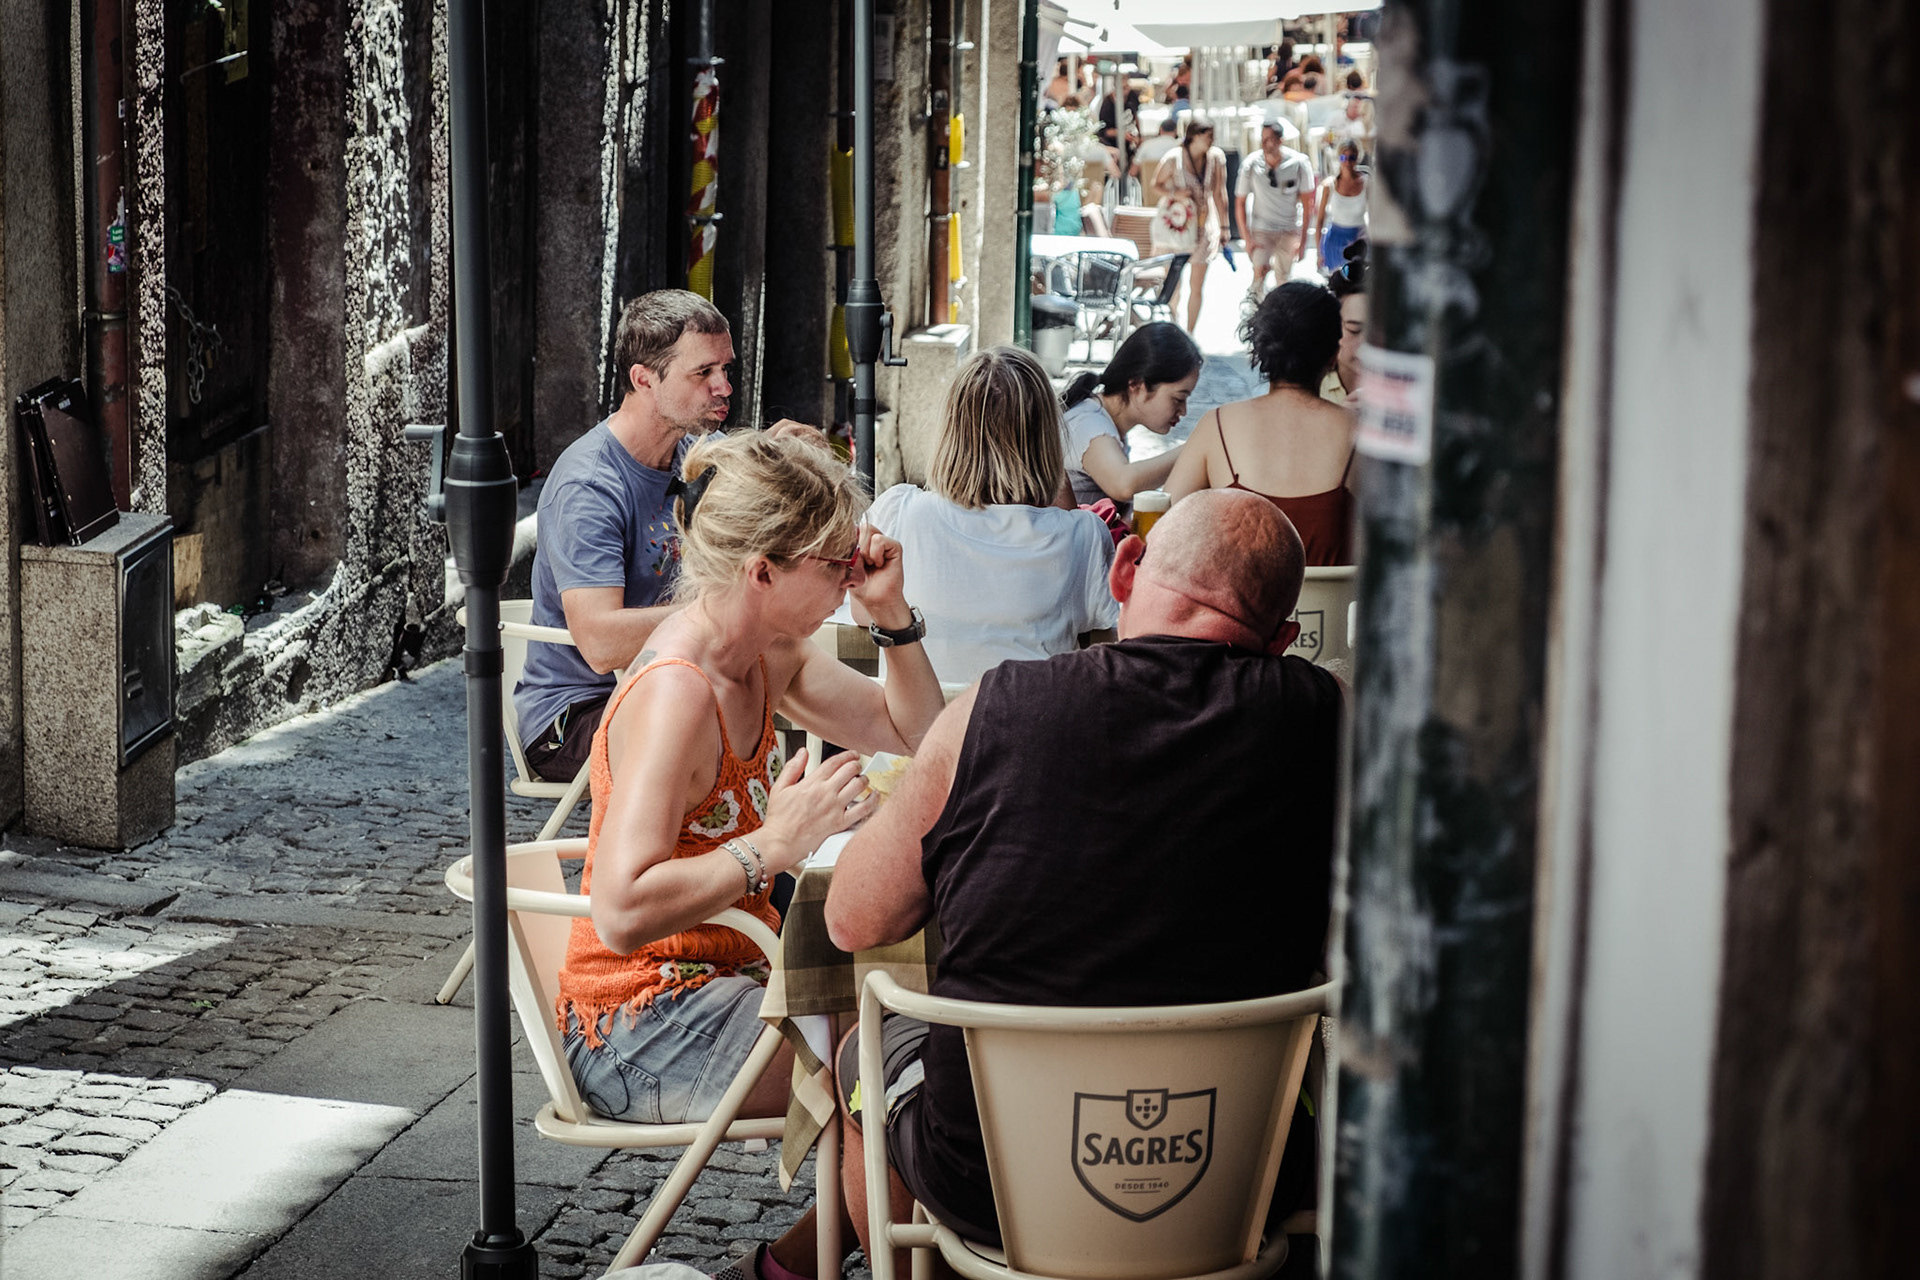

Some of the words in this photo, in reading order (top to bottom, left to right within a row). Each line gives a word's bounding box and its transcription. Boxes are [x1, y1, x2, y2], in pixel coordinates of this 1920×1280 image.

[1082, 1129, 1203, 1166] SAGRES
[1114, 1182, 1145, 1190] DESDE
[1148, 1181, 1169, 1189] 1940
